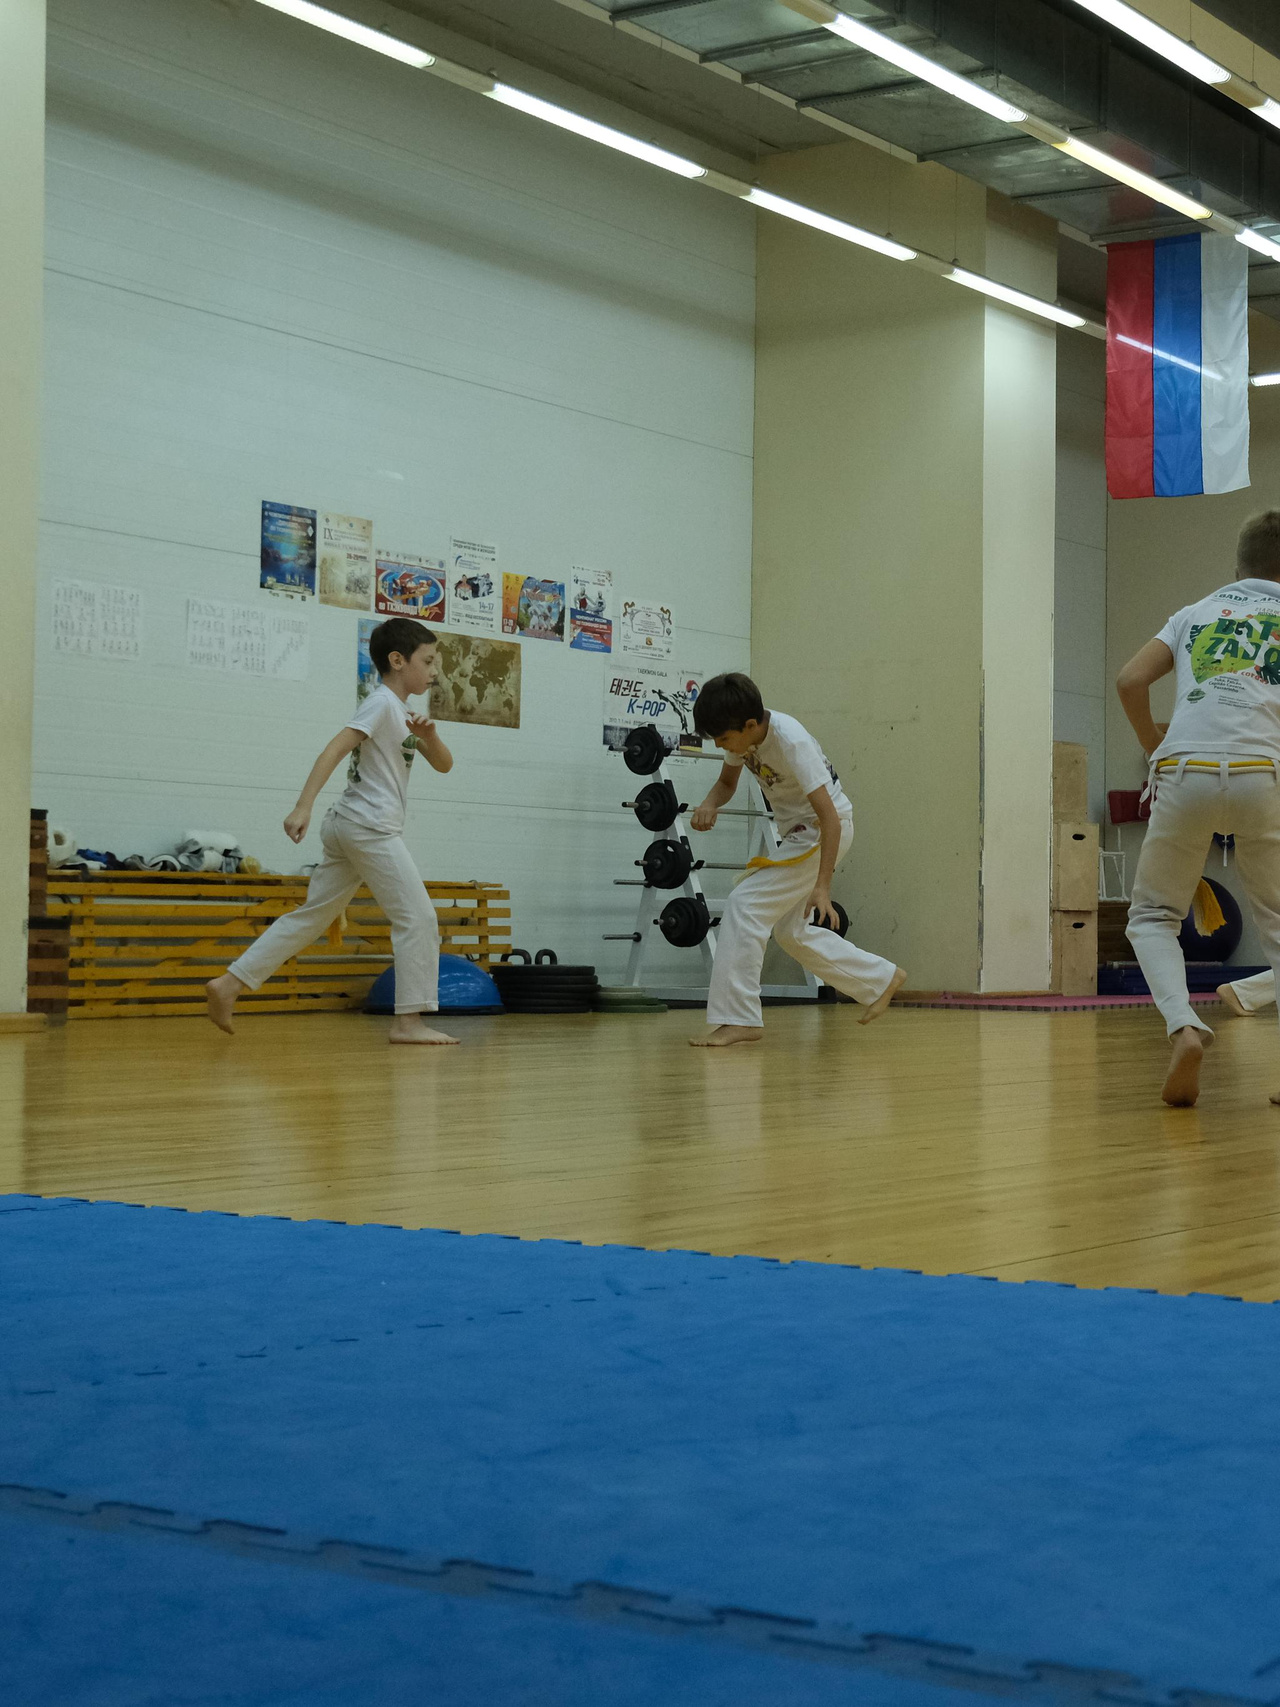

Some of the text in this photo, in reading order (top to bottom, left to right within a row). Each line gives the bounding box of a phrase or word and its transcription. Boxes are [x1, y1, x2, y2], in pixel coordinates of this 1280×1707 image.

[323, 527, 334, 540] IX
[609, 678, 644, 699] 태권도
[627, 698, 667, 717] K-POP
